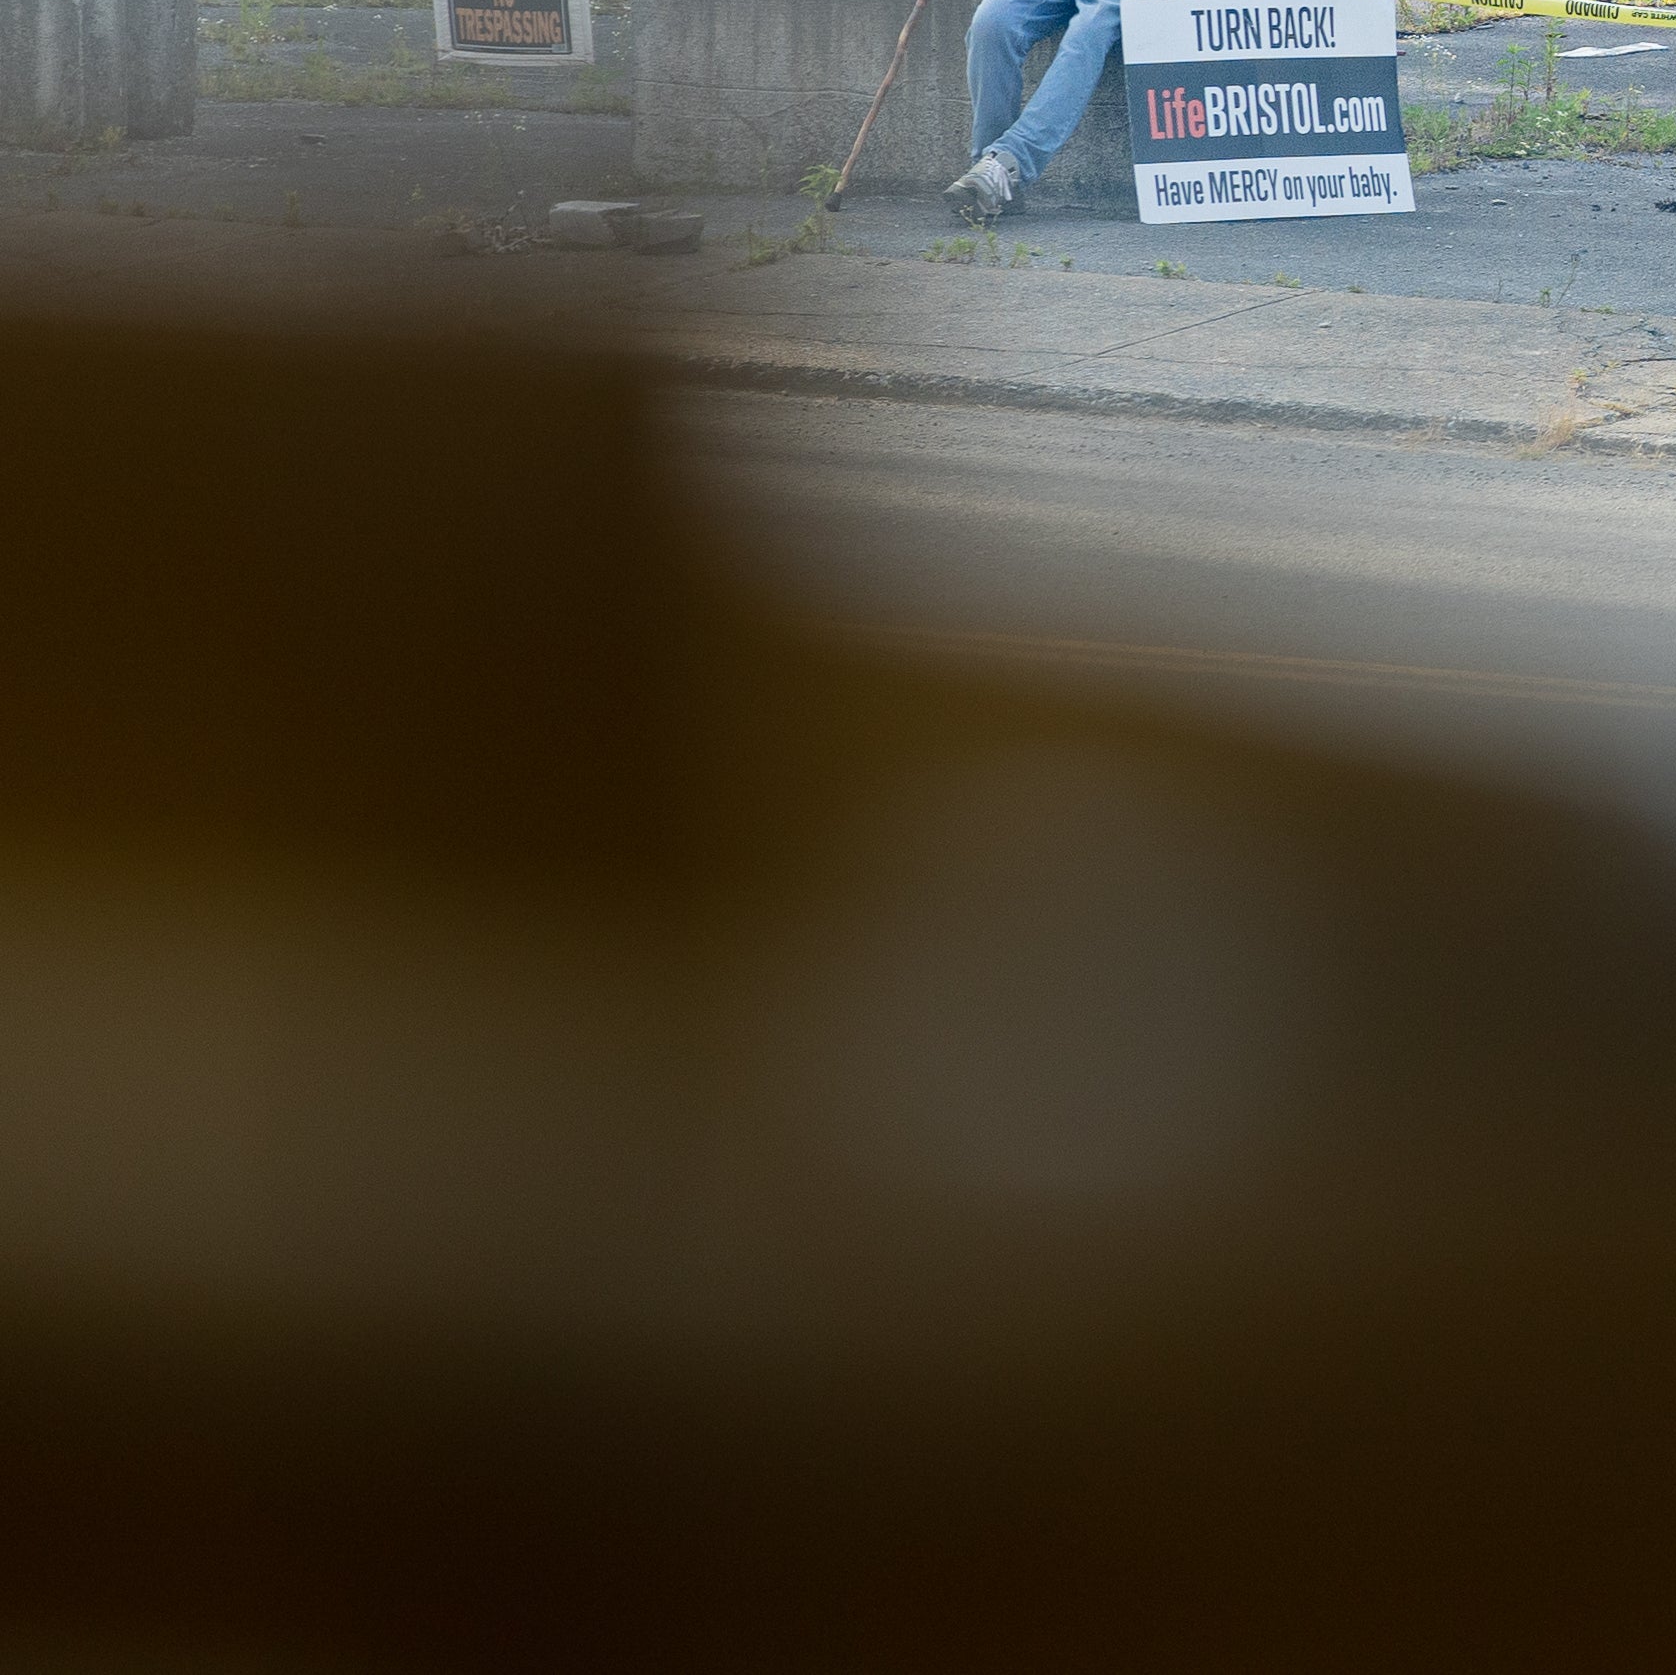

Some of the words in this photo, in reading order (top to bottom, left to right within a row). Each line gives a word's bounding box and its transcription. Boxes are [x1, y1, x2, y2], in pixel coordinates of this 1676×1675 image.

[455, 7, 562, 44] TRESPASSING
[1190, 8, 1262, 52] TURN
[1268, 6, 1337, 49] BACK!
[1566, 0, 1619, 19] CUIDADO
[1631, 11, 1649, 19] CAP
[1146, 82, 1387, 140] LifeBRISTOL.com
[1154, 174, 1204, 207] Have
[1208, 169, 1278, 203] MERCY
[1283, 178, 1304, 201] on
[1307, 174, 1345, 207] your
[1349, 166, 1398, 204] baby.
